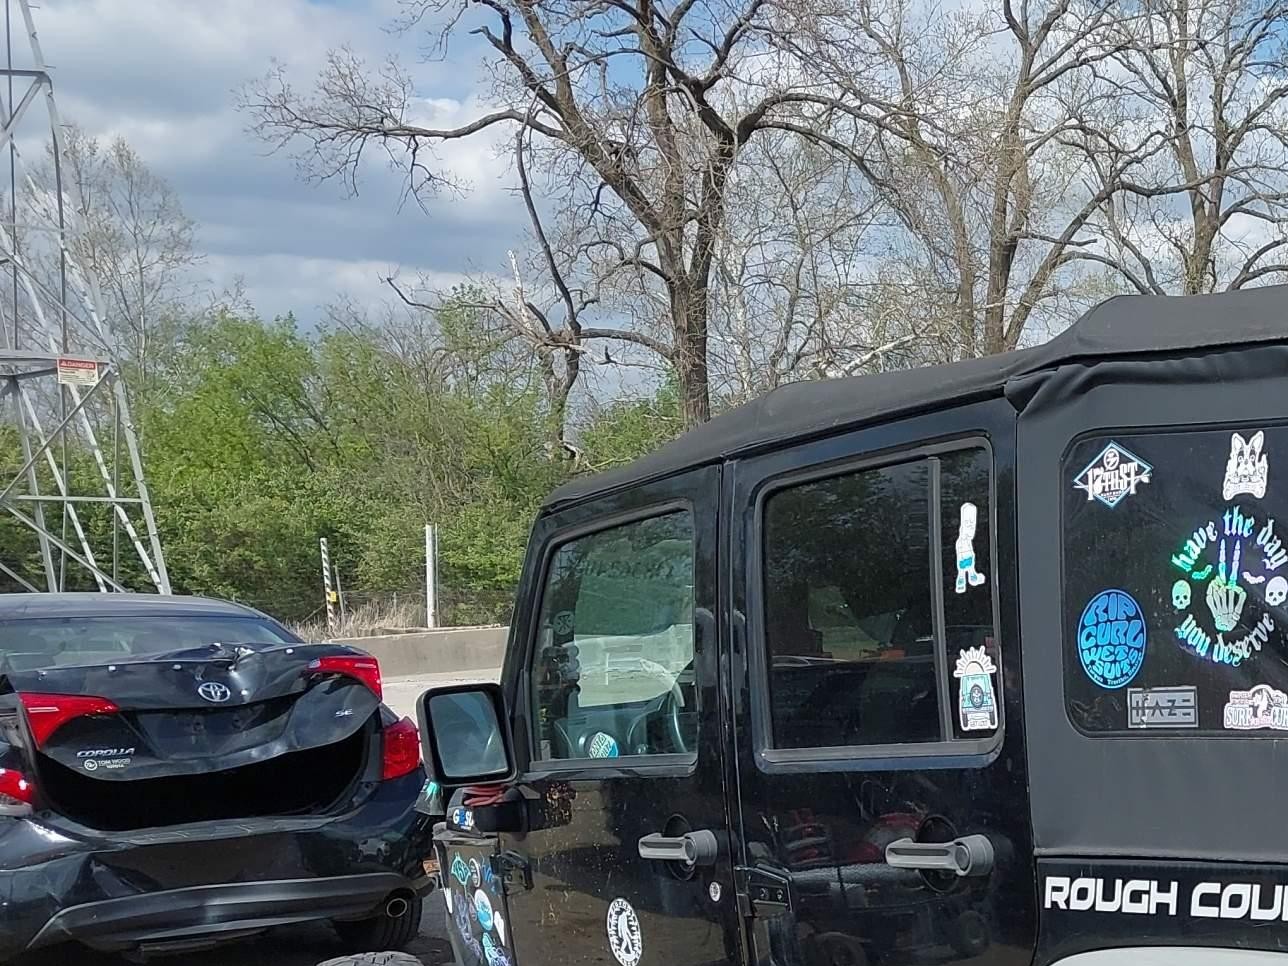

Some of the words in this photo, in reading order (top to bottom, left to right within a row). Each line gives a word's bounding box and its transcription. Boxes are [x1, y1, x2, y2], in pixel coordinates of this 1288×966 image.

[1171, 521, 1218, 572] have
[1223, 505, 1255, 538] the
[1256, 518, 1288, 571] day
[1084, 593, 1136, 626] RIP
[1081, 620, 1144, 649] CURL
[1174, 614, 1211, 657] you
[1213, 613, 1275, 667] deserve
[77, 748, 135, 757] COROLLA
[1044, 876, 1178, 915] ROUGH
